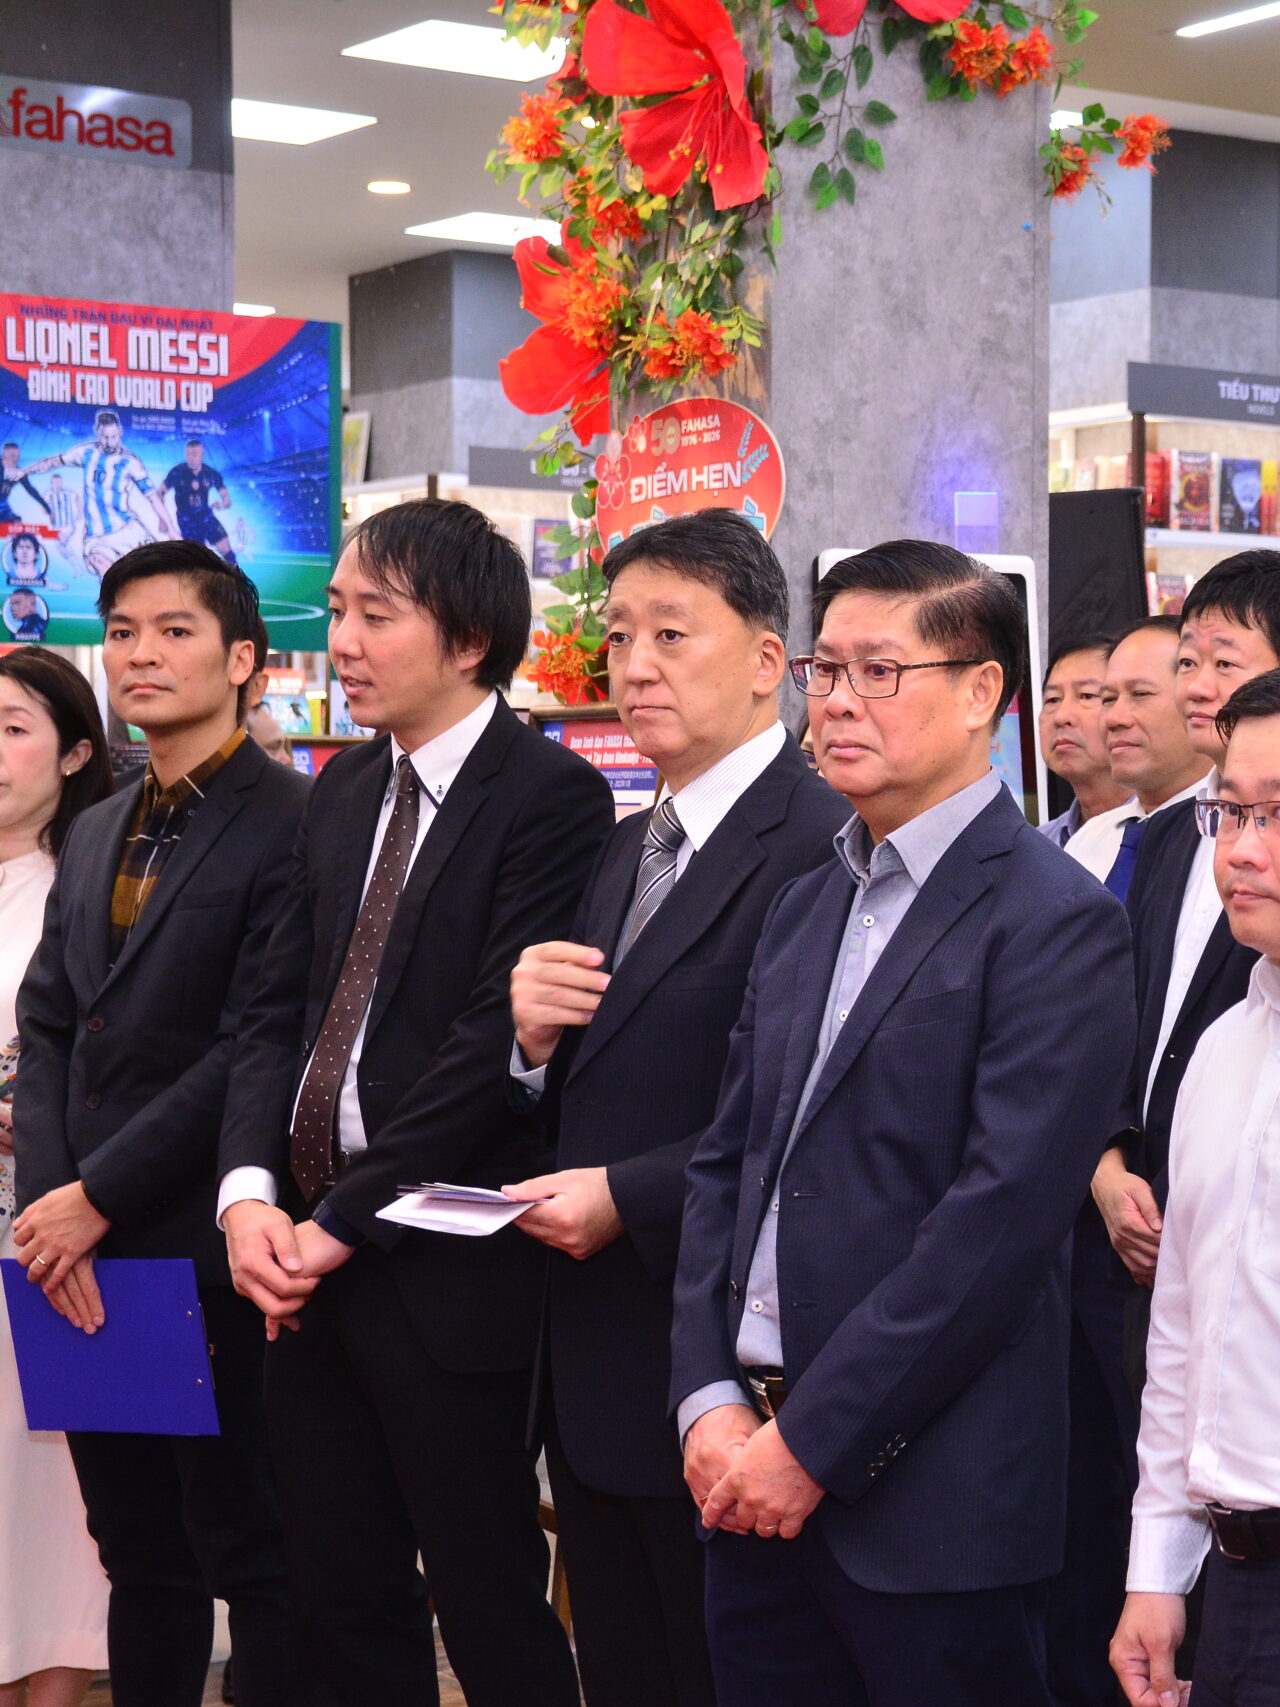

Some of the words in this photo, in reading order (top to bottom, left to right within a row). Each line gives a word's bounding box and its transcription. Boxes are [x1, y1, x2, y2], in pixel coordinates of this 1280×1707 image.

[7, 87, 176, 157] fahasa
[5, 316, 117, 369] LIONEL
[127, 328, 229, 377] MESSI
[27, 362, 71, 403] ĐỈNH
[75, 372, 110, 406] CAO
[113, 375, 177, 411] WORLD
[180, 380, 214, 413] CUP
[651, 416, 682, 457] 50
[681, 414, 721, 434] FAHASA
[703, 430, 721, 444] 2026
[630, 461, 688, 504] ĐIỂM
[691, 460, 743, 497] HẸN
